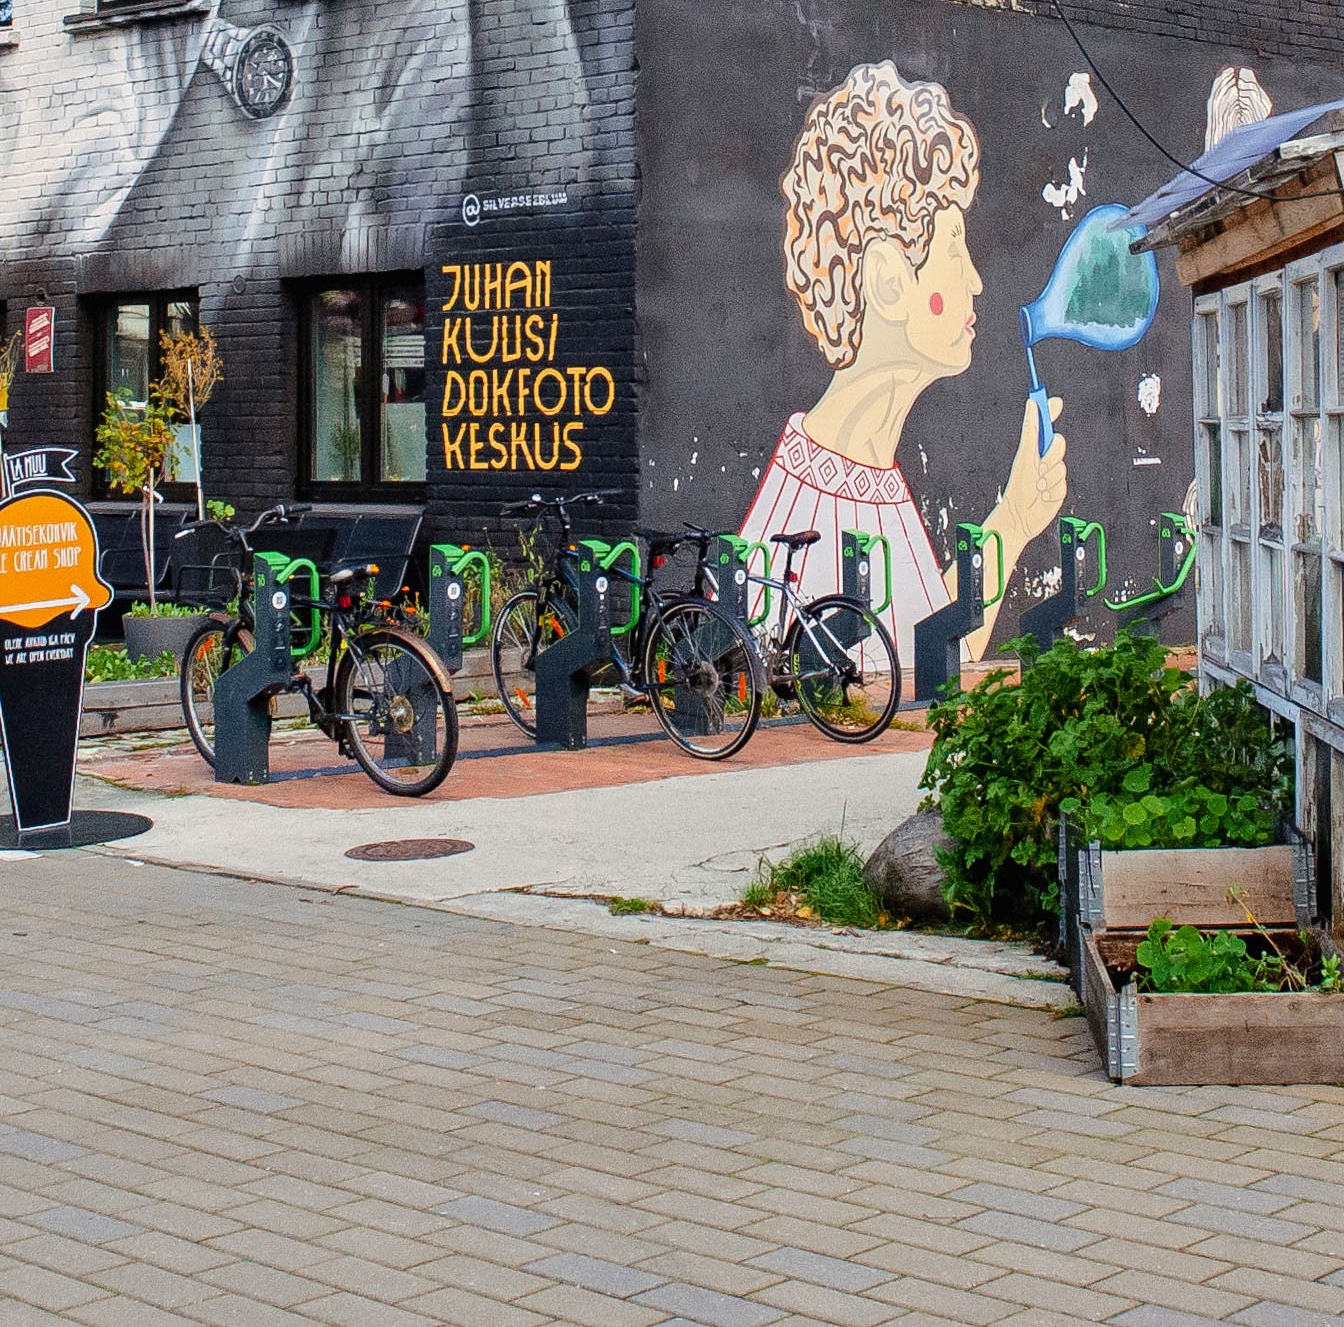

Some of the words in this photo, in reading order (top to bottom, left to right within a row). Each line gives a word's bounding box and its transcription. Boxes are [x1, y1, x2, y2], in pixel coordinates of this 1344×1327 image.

[442, 261, 551, 311] JUHAN
[442, 367, 615, 417] DOKFOTO
[10, 457, 24, 481] LA
[24, 454, 47, 478] MUU
[442, 422, 584, 471] KESKUS
[14, 548, 48, 572] CREAM
[53, 546, 81, 569] SHOP
